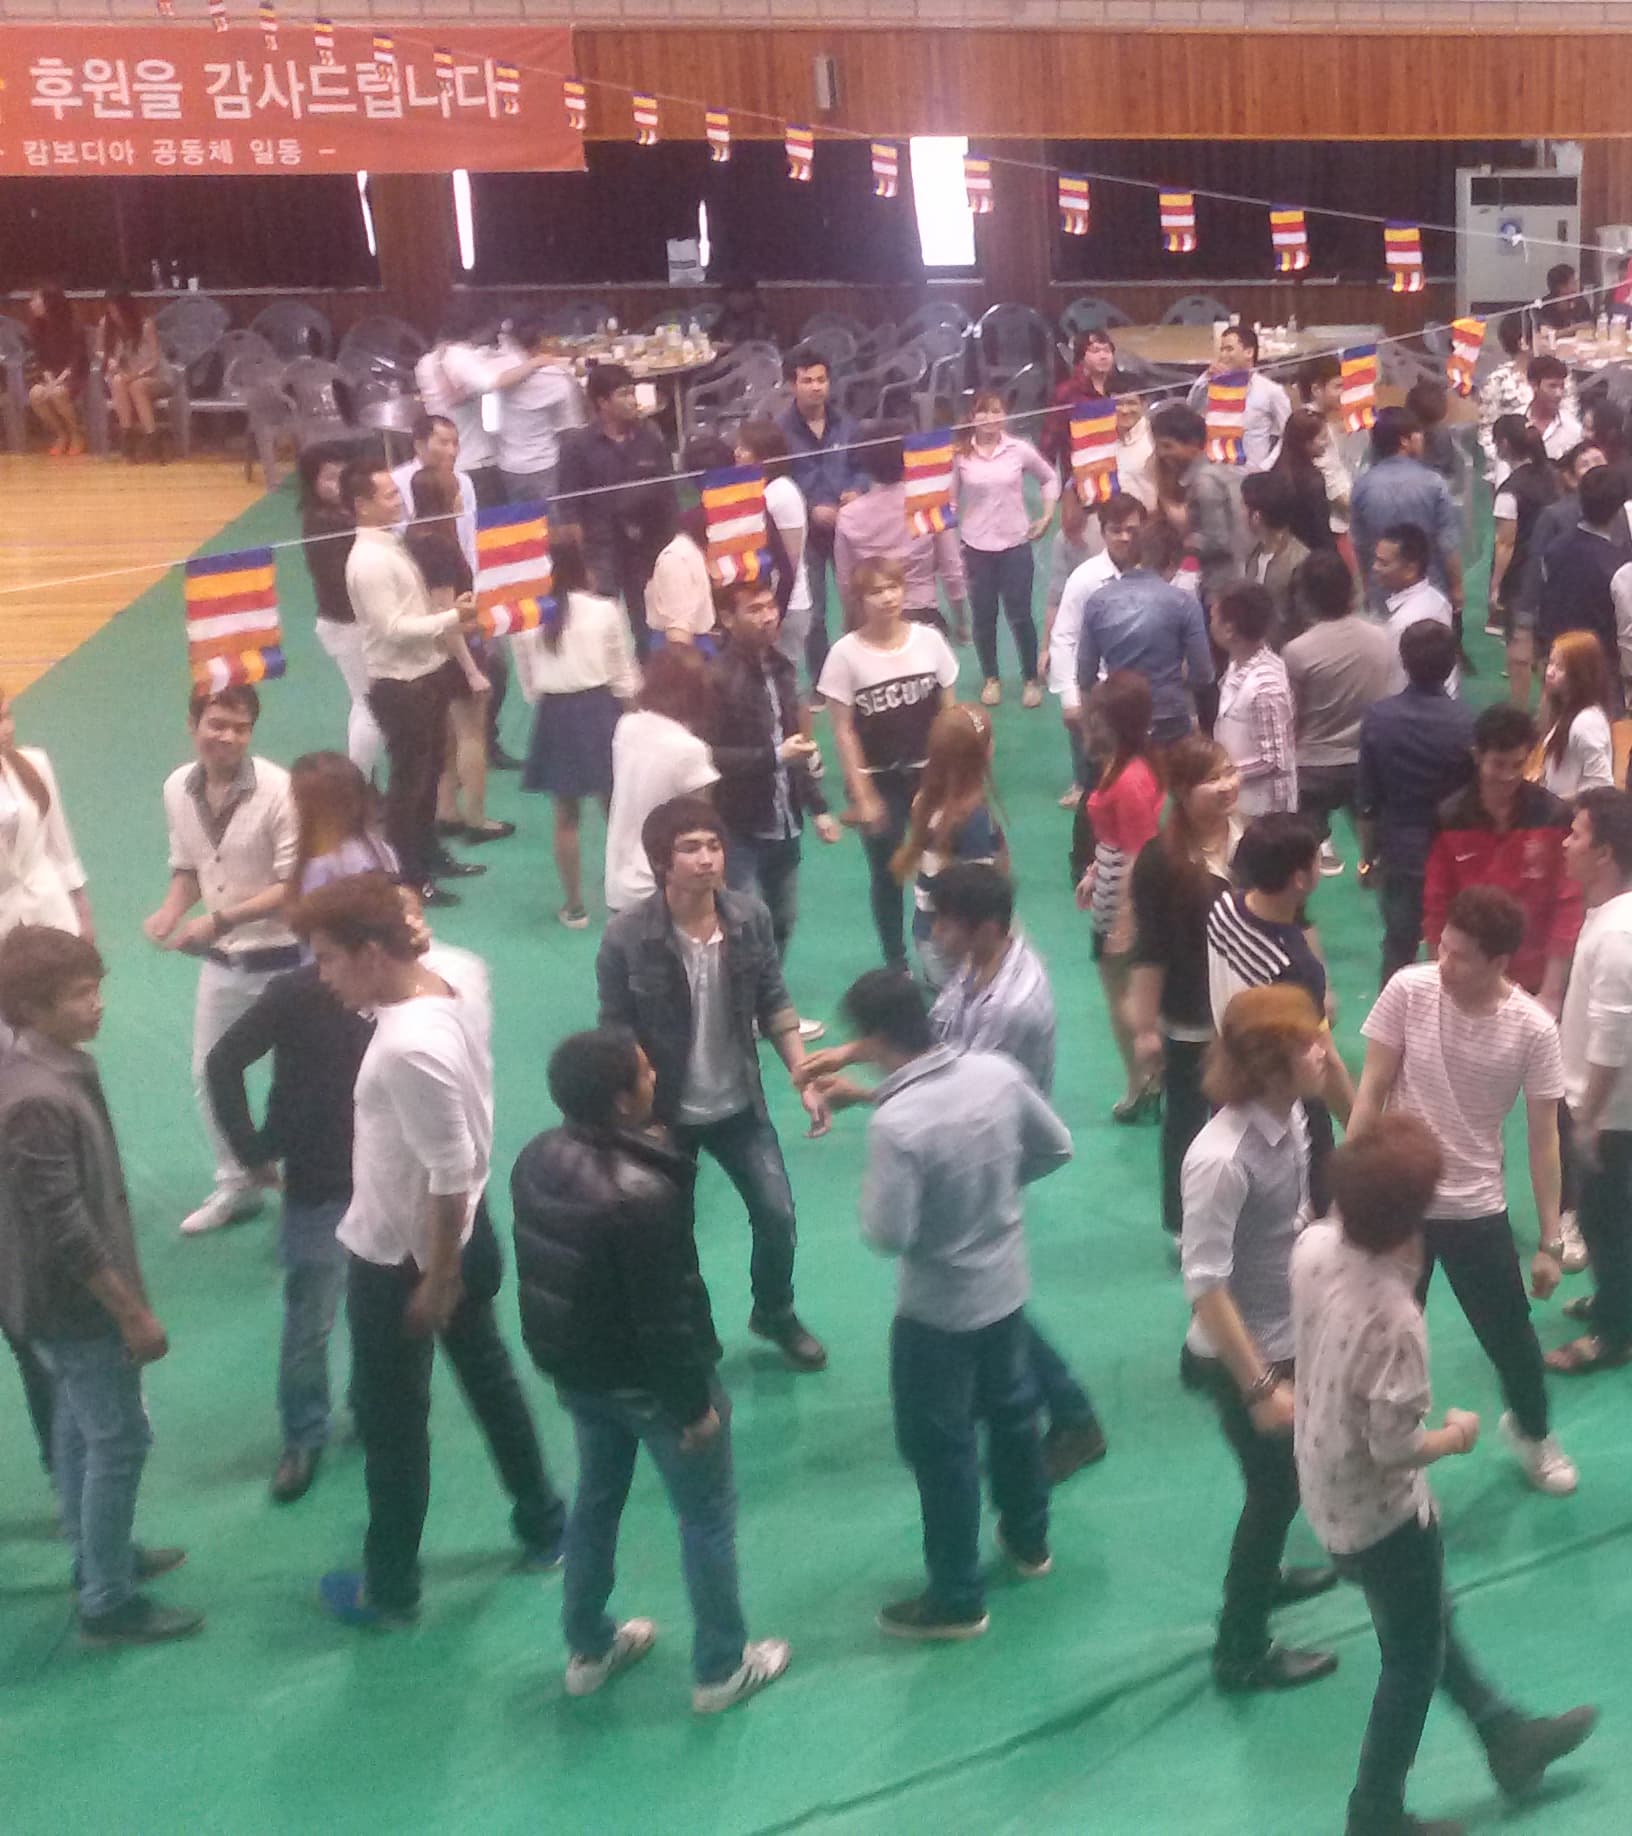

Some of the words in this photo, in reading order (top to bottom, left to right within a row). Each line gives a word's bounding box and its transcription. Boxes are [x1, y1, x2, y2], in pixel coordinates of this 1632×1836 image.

[29, 57, 184, 120] 후원을
[203, 59, 498, 120] 감사드립니다
[151, 138, 233, 166] 공동체
[249, 138, 303, 166] 일동
